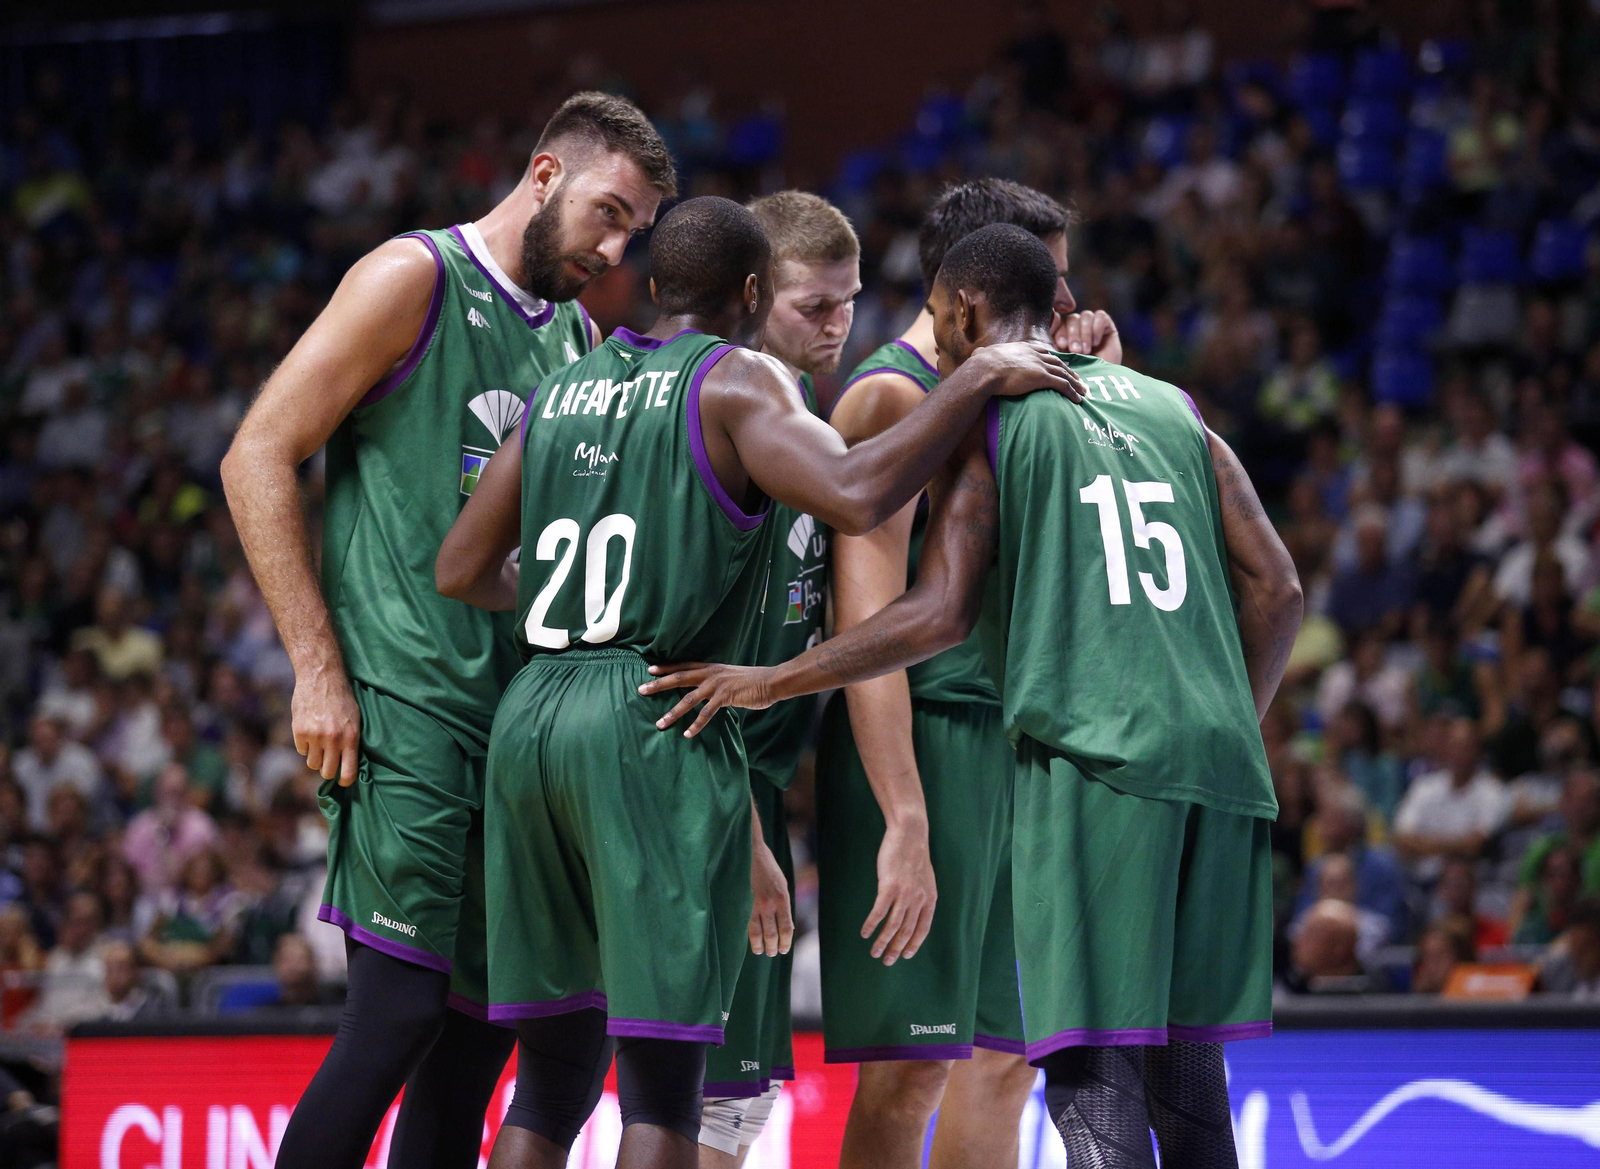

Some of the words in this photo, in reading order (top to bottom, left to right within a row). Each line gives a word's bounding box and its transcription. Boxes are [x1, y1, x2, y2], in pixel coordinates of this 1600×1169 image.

[541, 370, 680, 420] LAFAYETTE
[1079, 474, 1188, 612] 15
[524, 513, 637, 650] 20
[371, 911, 417, 938] SPALDING
[910, 1023, 956, 1036] SPALDING
